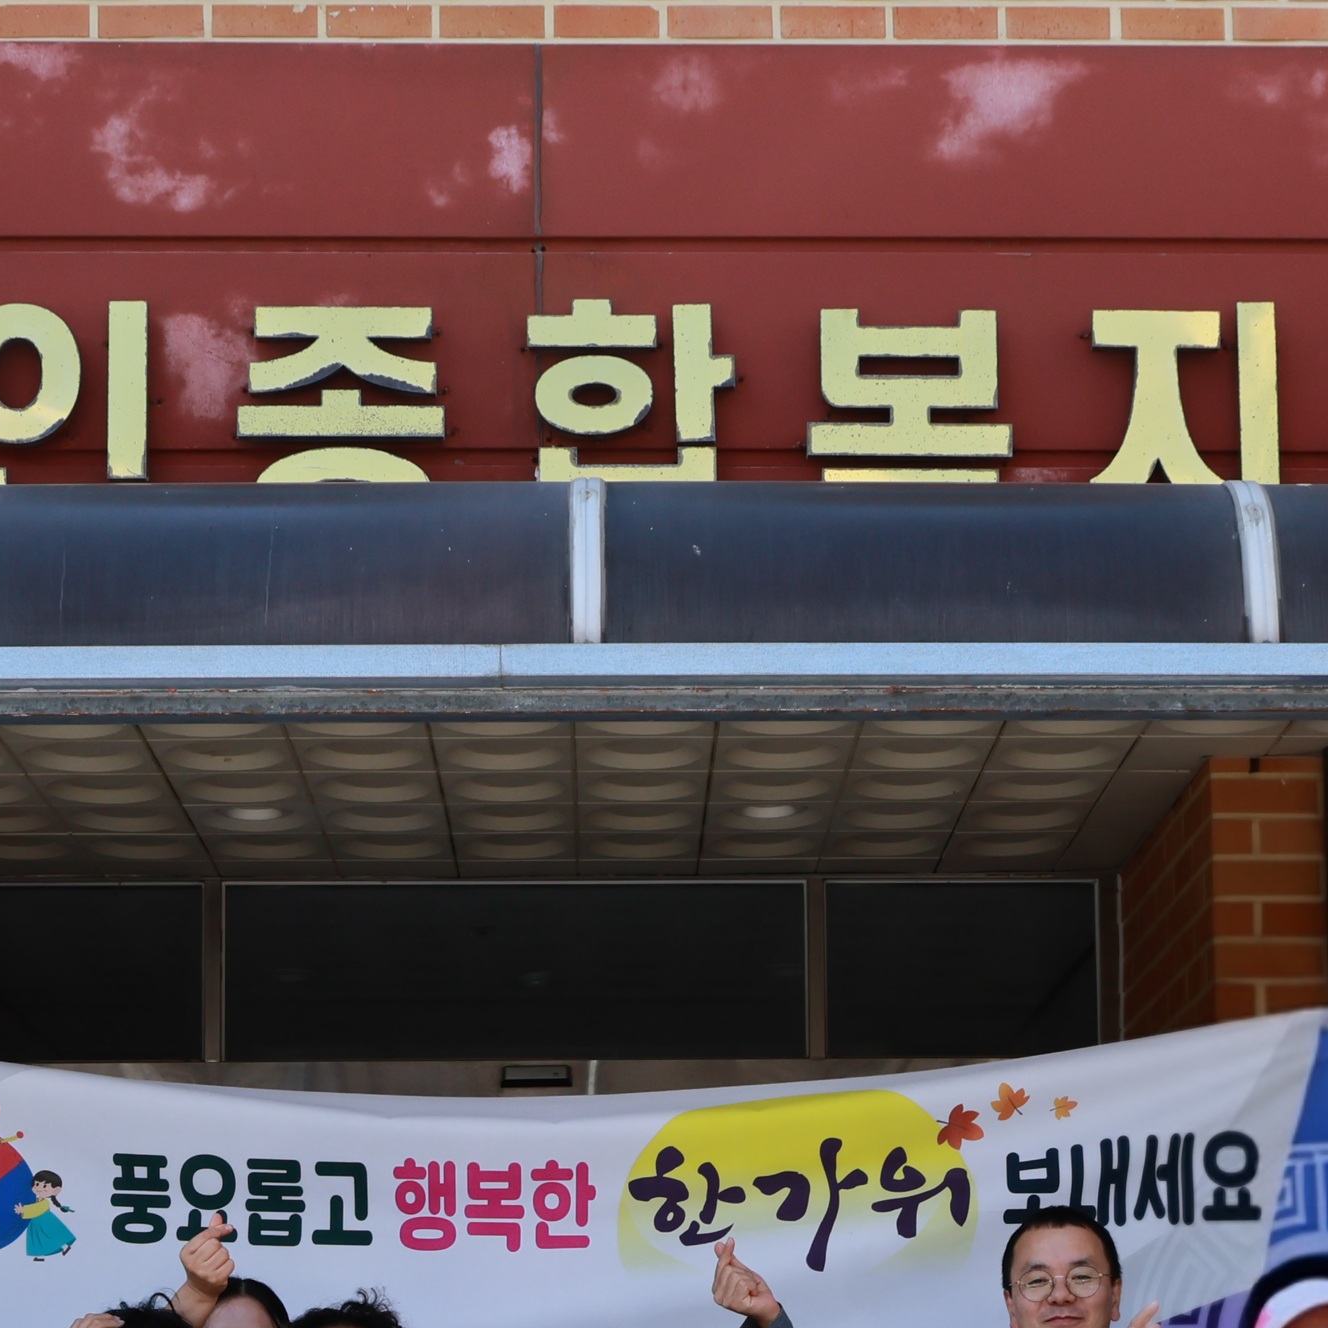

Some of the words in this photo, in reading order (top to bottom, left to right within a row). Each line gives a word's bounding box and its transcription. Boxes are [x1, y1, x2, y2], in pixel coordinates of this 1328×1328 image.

[110, 1152, 374, 1246] 풍요롭고
[393, 1157, 597, 1252] 행복한
[629, 1137, 972, 1272] 한가위
